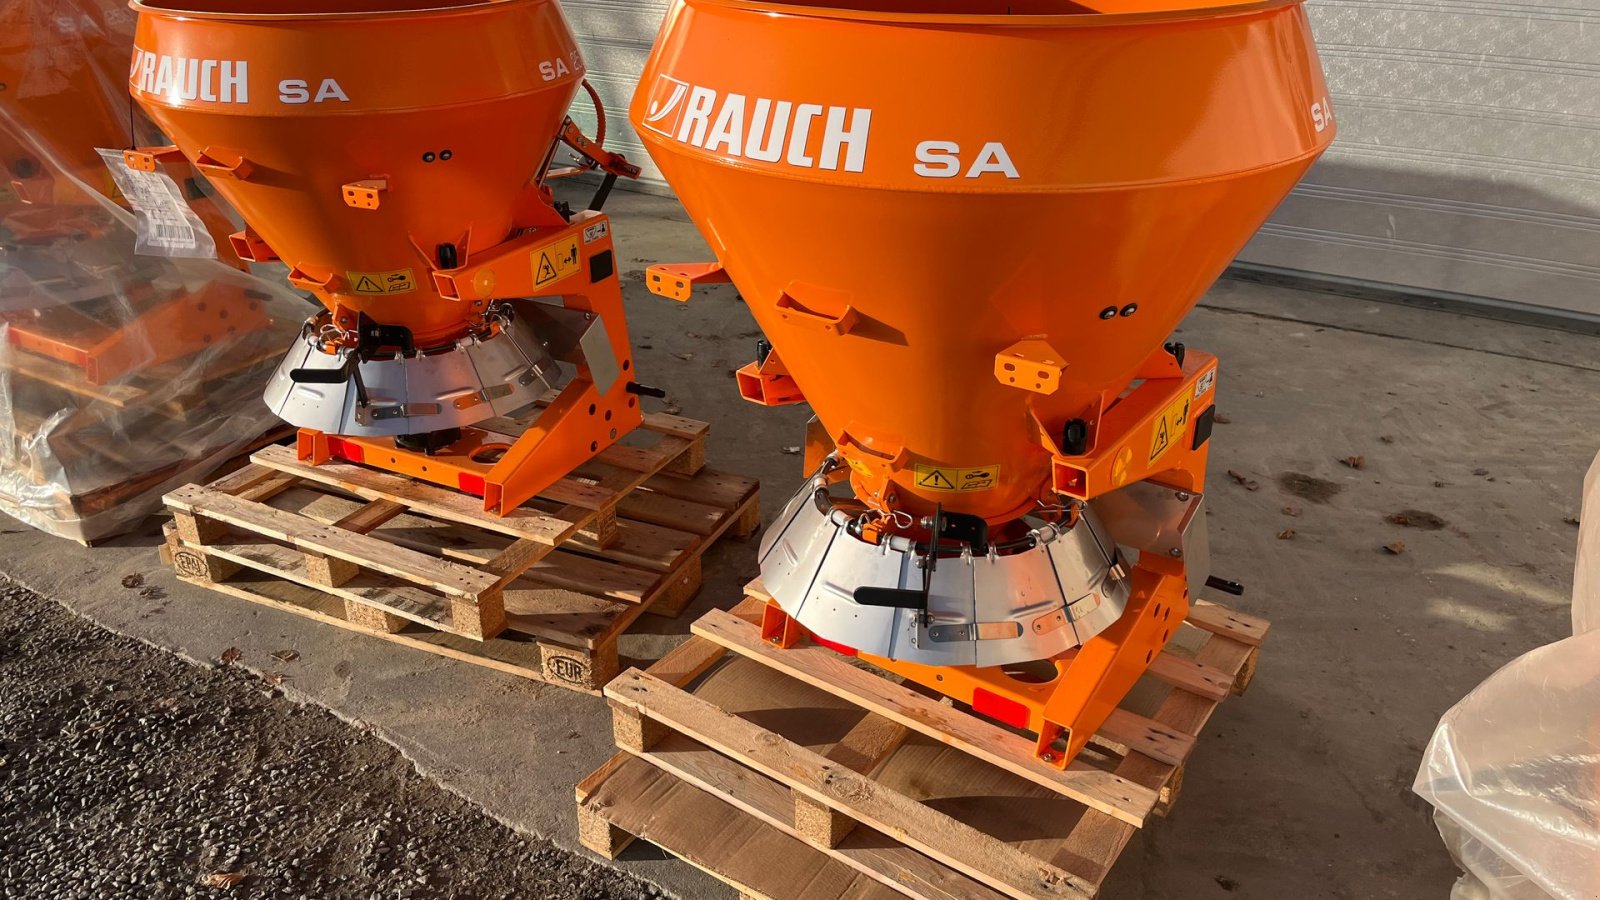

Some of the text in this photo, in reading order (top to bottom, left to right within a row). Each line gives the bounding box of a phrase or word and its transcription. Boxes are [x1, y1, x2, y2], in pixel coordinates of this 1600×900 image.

[141, 51, 248, 103] RAUCH
[538, 57, 570, 82] SA
[278, 78, 350, 104] SA
[677, 85, 872, 173] RAUCH
[1310, 97, 1333, 133] SA
[913, 140, 1021, 179] SA
[555, 659, 582, 681] EUR
